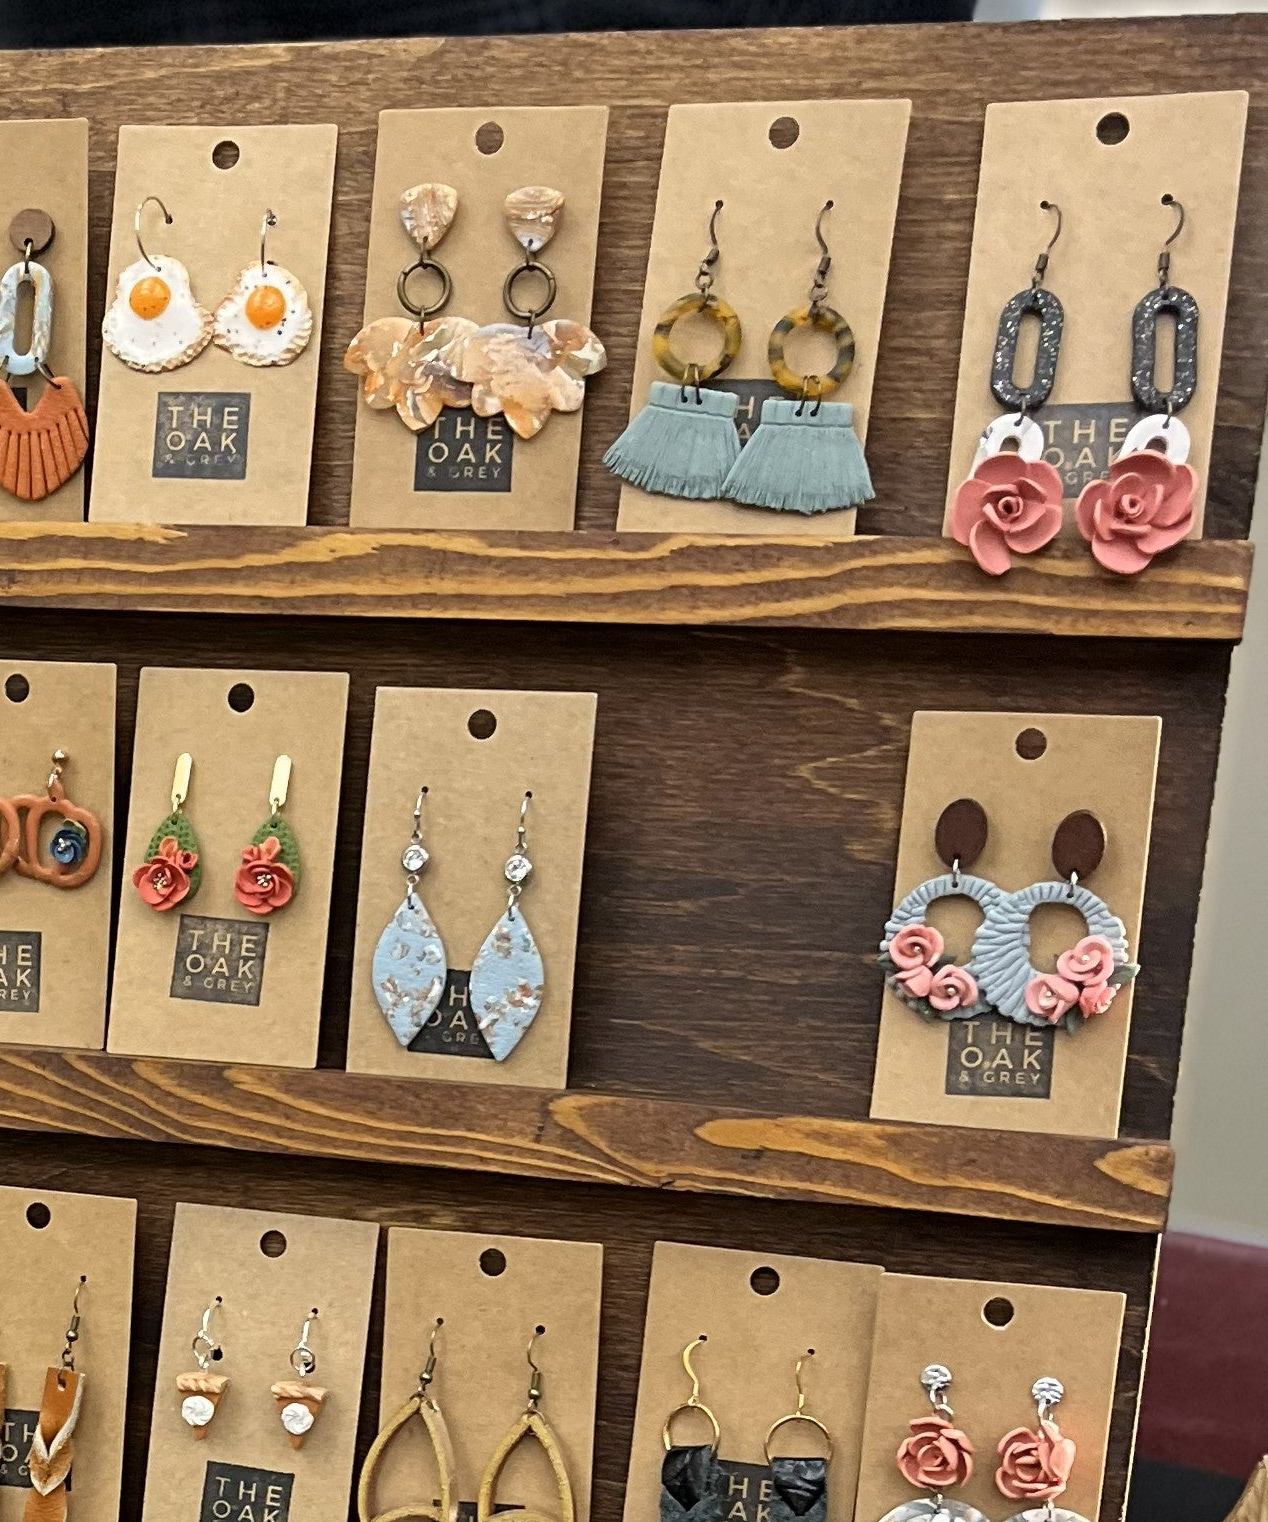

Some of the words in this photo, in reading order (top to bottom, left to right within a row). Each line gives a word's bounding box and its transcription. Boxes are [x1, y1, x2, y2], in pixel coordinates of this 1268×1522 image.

[167, 406, 240, 429] THE
[434, 416, 504, 440] THE
[166, 430, 237, 454] OAK
[1043, 418, 1129, 444] THE
[428, 442, 503, 464] OAK
[451, 467, 502, 480] GREY
[1064, 470, 1110, 485] GRE
[188, 929, 258, 957] THE
[185, 953, 254, 979] OAK
[204, 977, 254, 993] GREY
[442, 1030, 479, 1046] GRE
[962, 1021, 1043, 1046] THE
[960, 1046, 1042, 1070] OAK
[958, 1070, 969, 1082] &
[983, 1071, 1040, 1085] GREY
[3, 1422, 35, 1444] TH
[214, 1476, 283, 1508] THE
[728, 1475, 773, 1502] HE
[728, 1501, 771, 1522] AK
